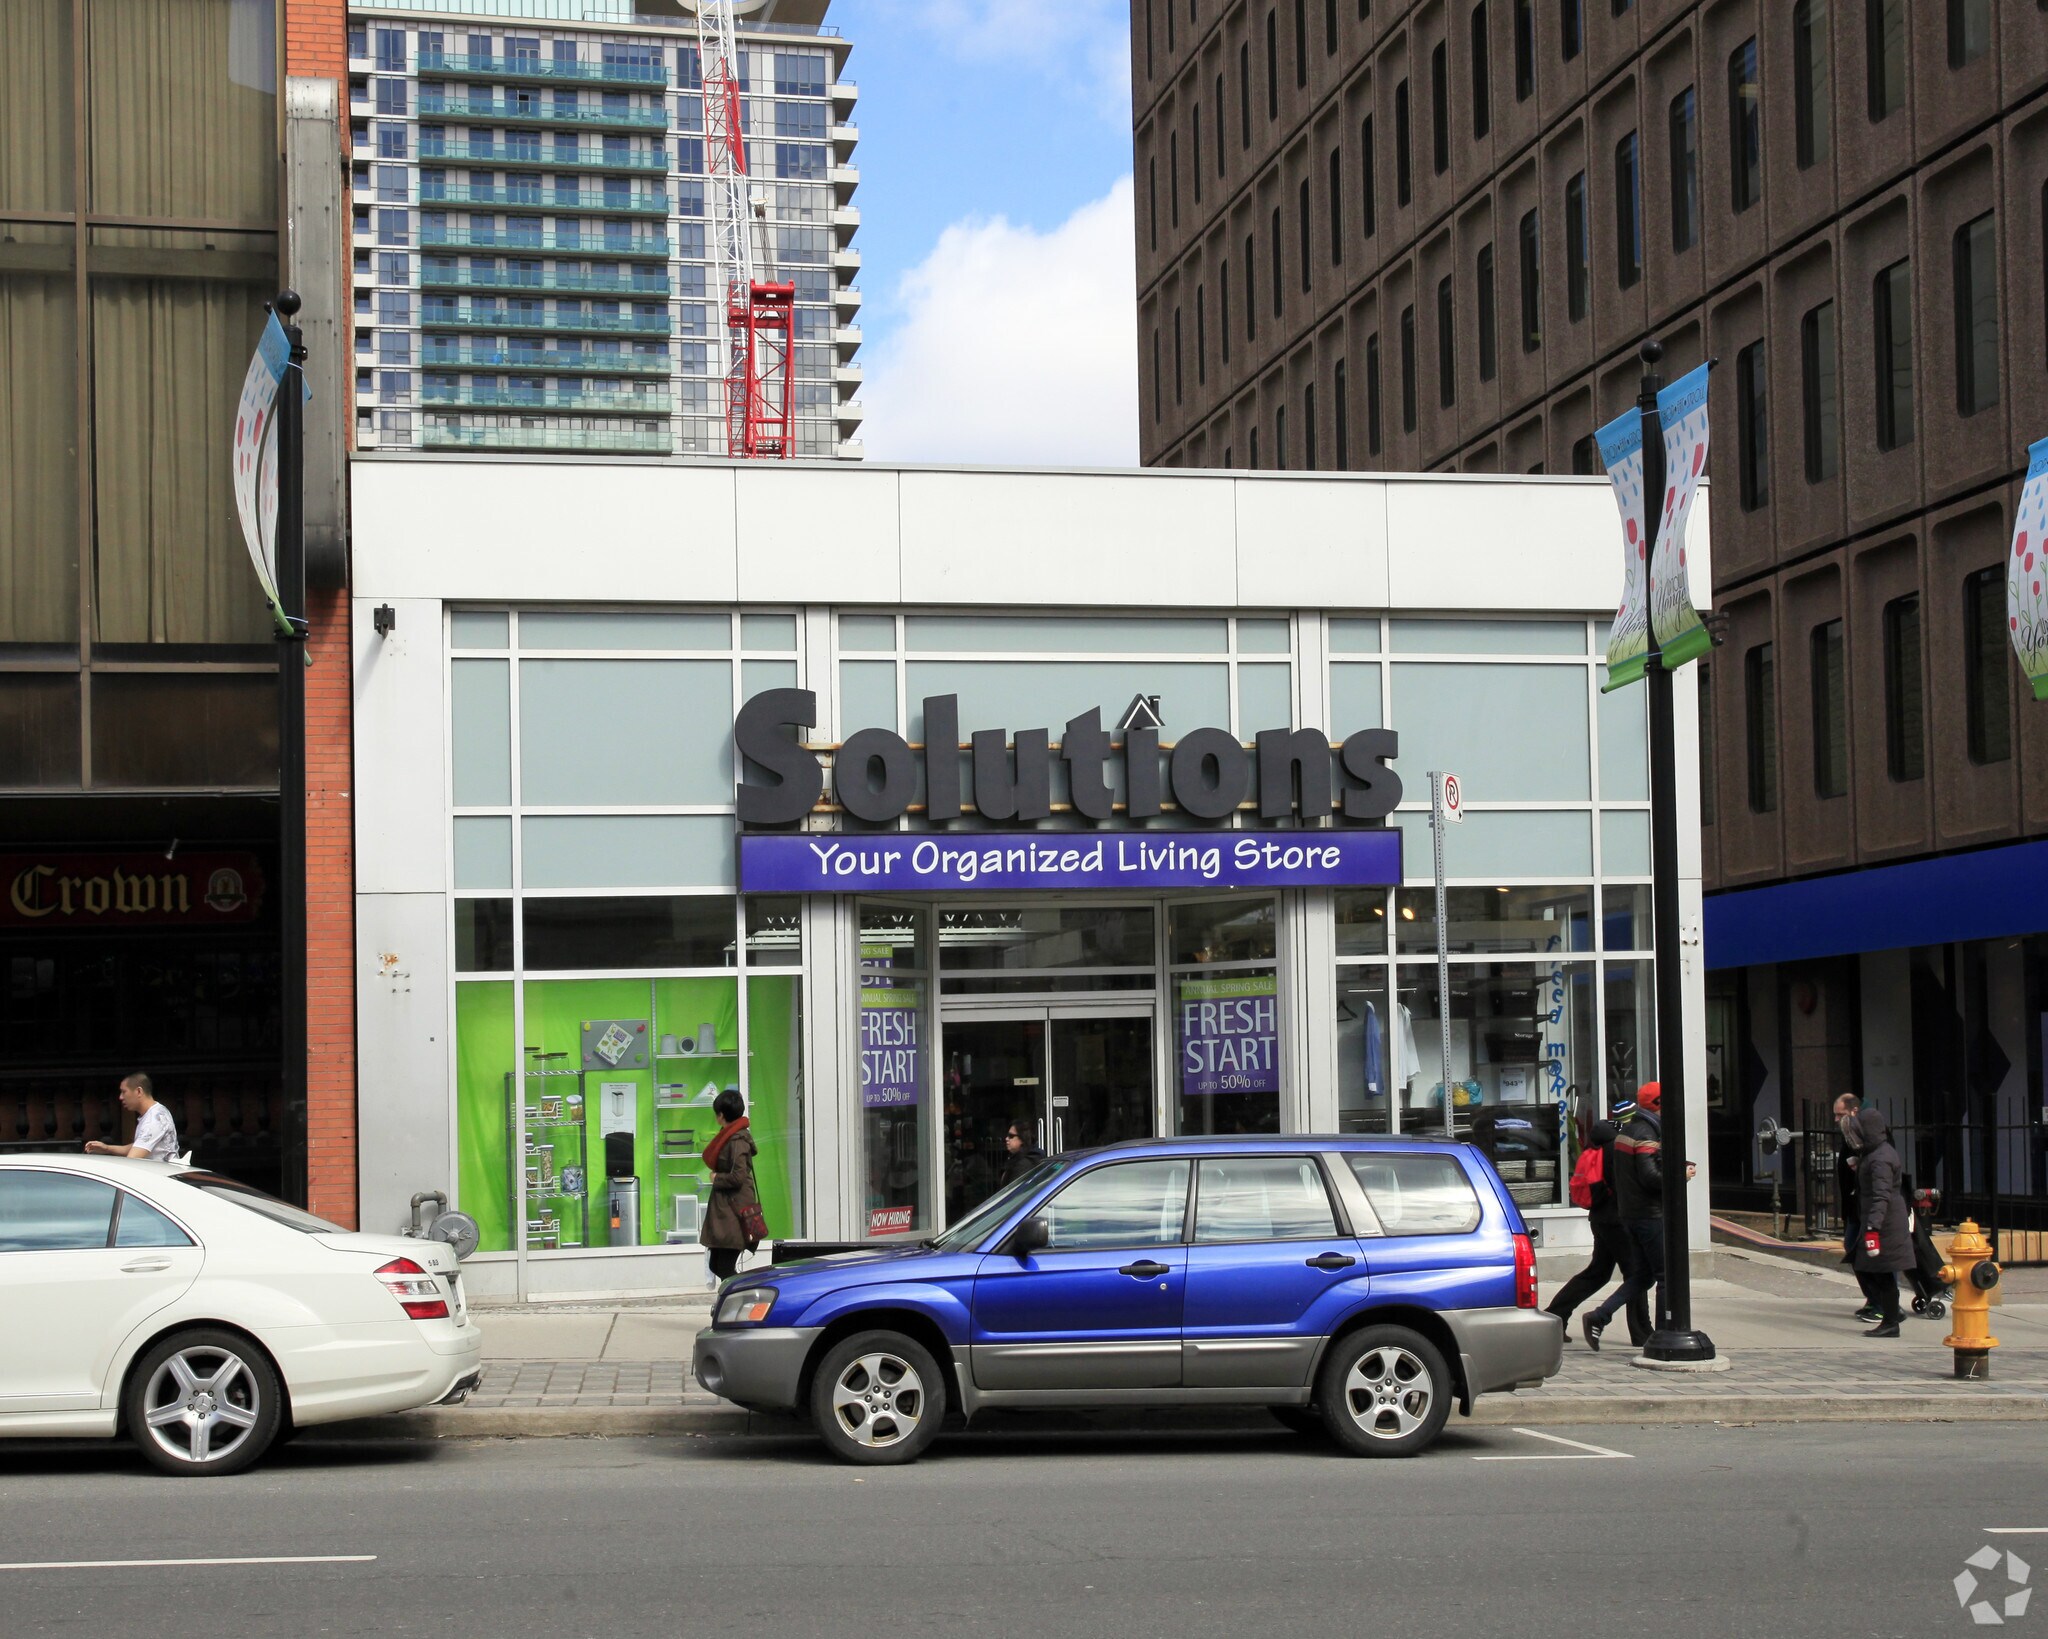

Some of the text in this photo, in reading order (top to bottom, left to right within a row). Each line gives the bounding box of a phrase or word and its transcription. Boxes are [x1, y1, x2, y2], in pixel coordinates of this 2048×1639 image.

[735, 688, 1403, 823] Solutions
[809, 839, 1341, 882] Your Organized Living Store
[10, 864, 191, 917] Crown
[873, 947, 889, 955] SALE
[1186, 981, 1273, 995] ANNUAL SPRING SALE
[1184, 999, 1275, 1036] FRESH
[862, 1050, 917, 1085] START
[1186, 1036, 1276, 1073] START
[866, 1094, 874, 1103] UP
[882, 1087, 901, 1102] 50%
[902, 1092, 910, 1101] OFF
[1198, 1074, 1266, 1090] UP TO 50% OFF
[871, 1210, 911, 1227] NOW HIRING
